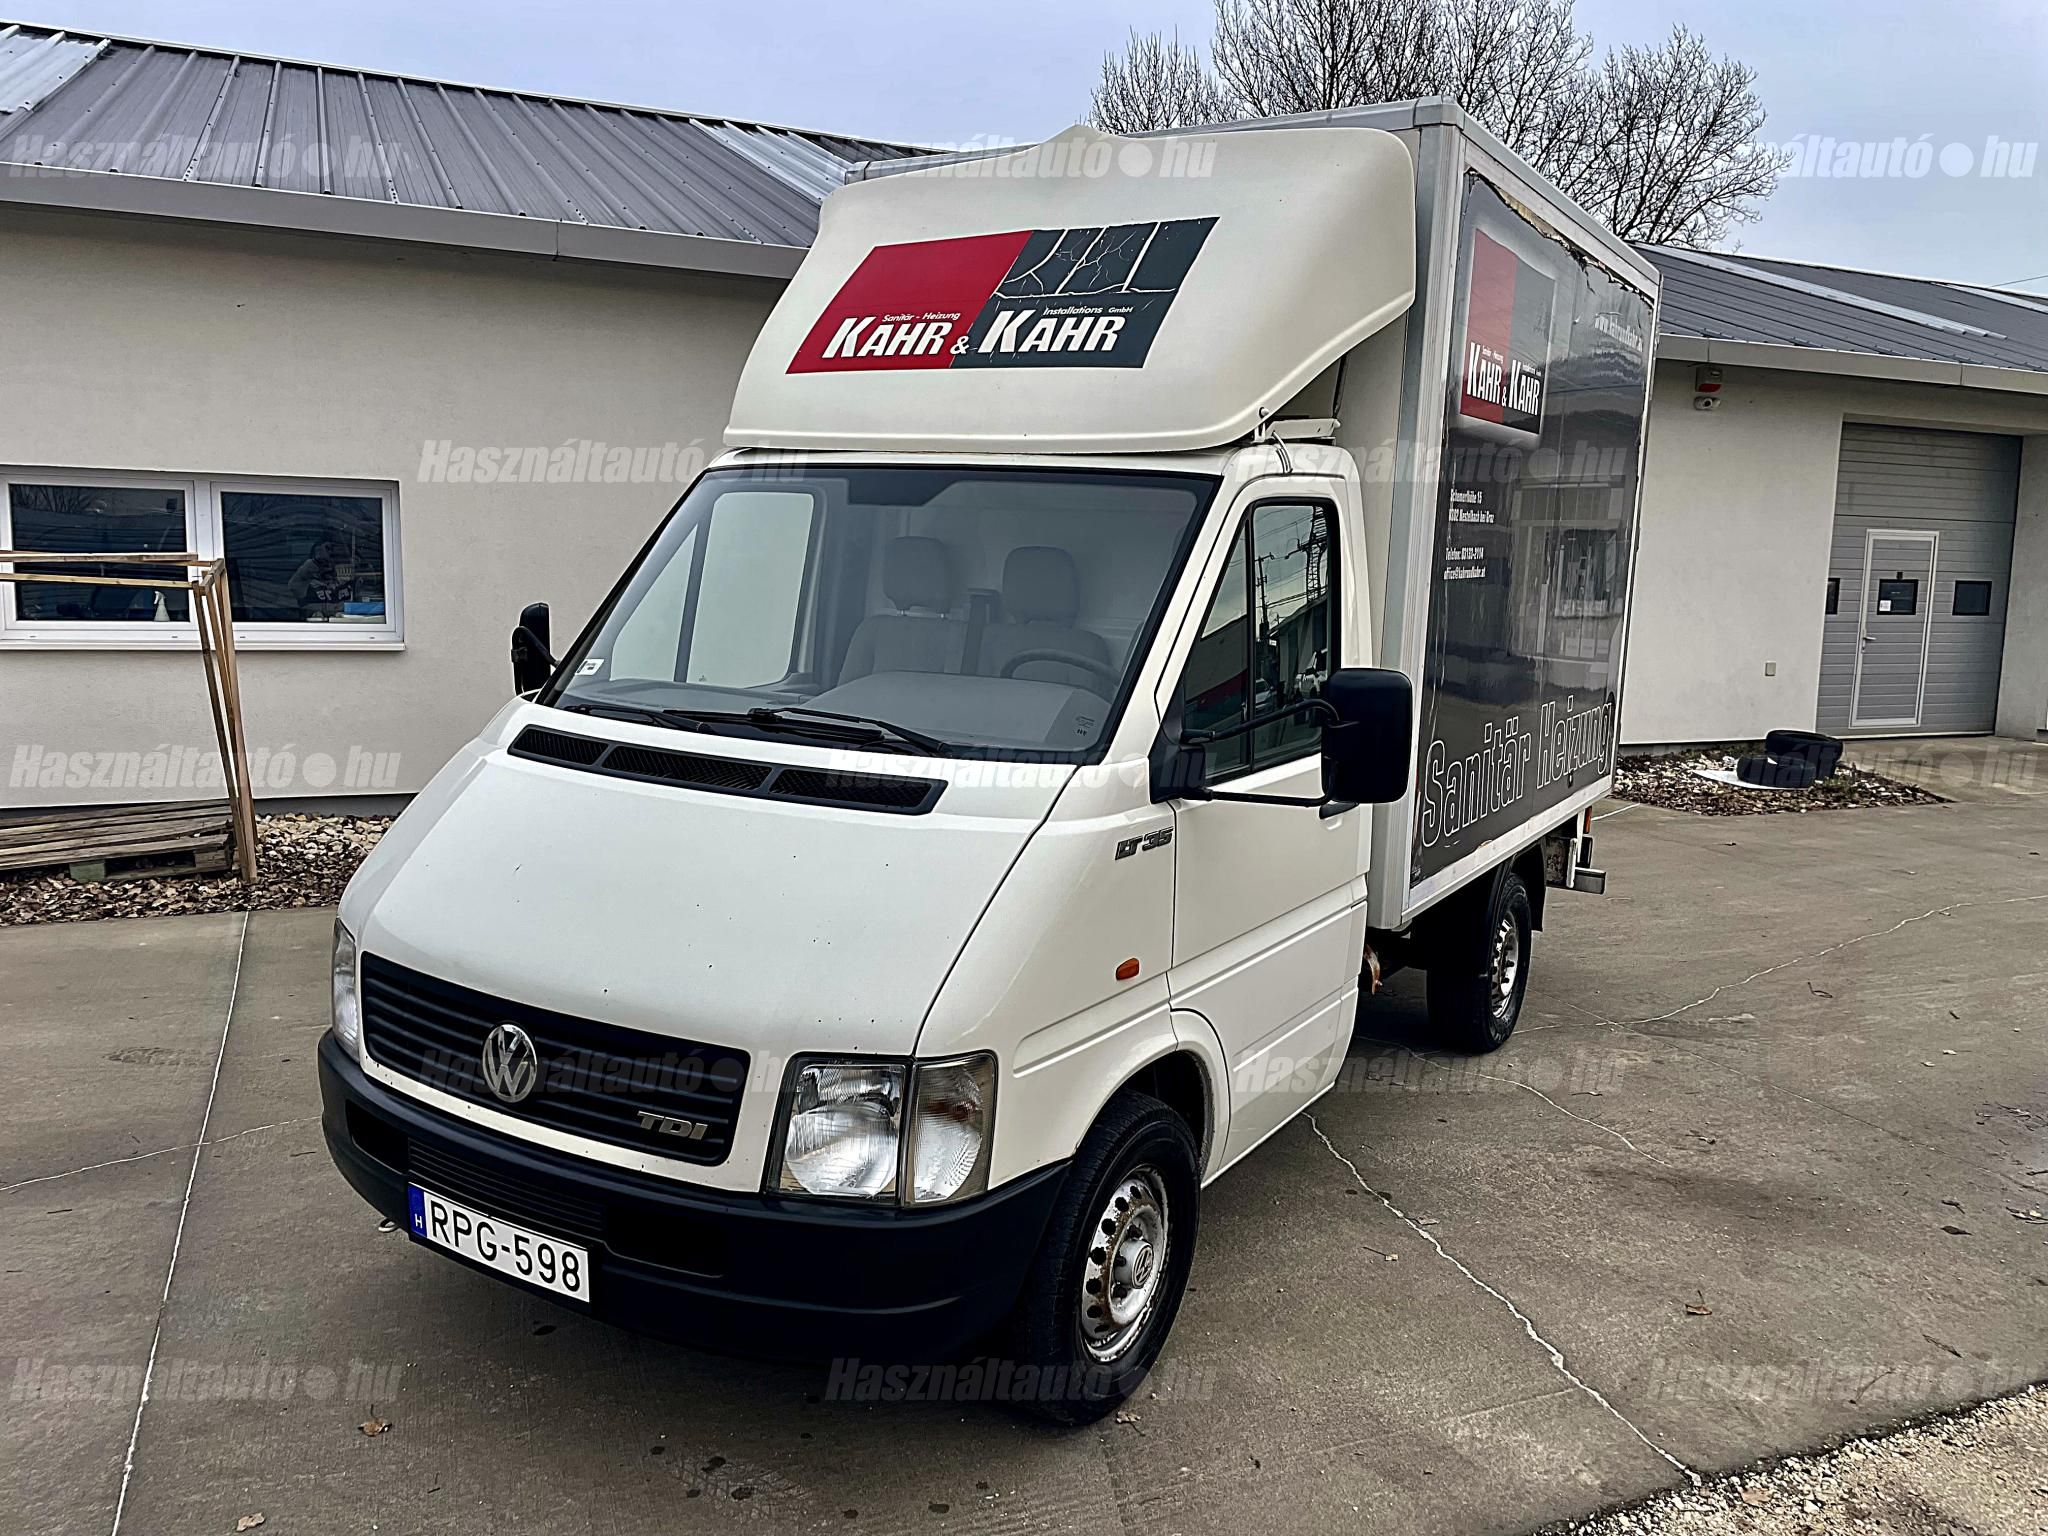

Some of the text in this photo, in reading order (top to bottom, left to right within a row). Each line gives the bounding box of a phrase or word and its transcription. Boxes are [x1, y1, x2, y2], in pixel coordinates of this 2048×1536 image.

[822, 309, 1126, 358] KAHR & KAHR
[882, 313, 914, 322] Sanitär
[922, 311, 961, 320] Heizung
[1043, 305, 1103, 316] Installations
[1467, 341, 1541, 416] KAHR & KAHR
[1422, 695, 1612, 847] Sanitär Heizung
[637, 1110, 708, 1141] TDI
[414, 1199, 581, 1292] H RPG-598
